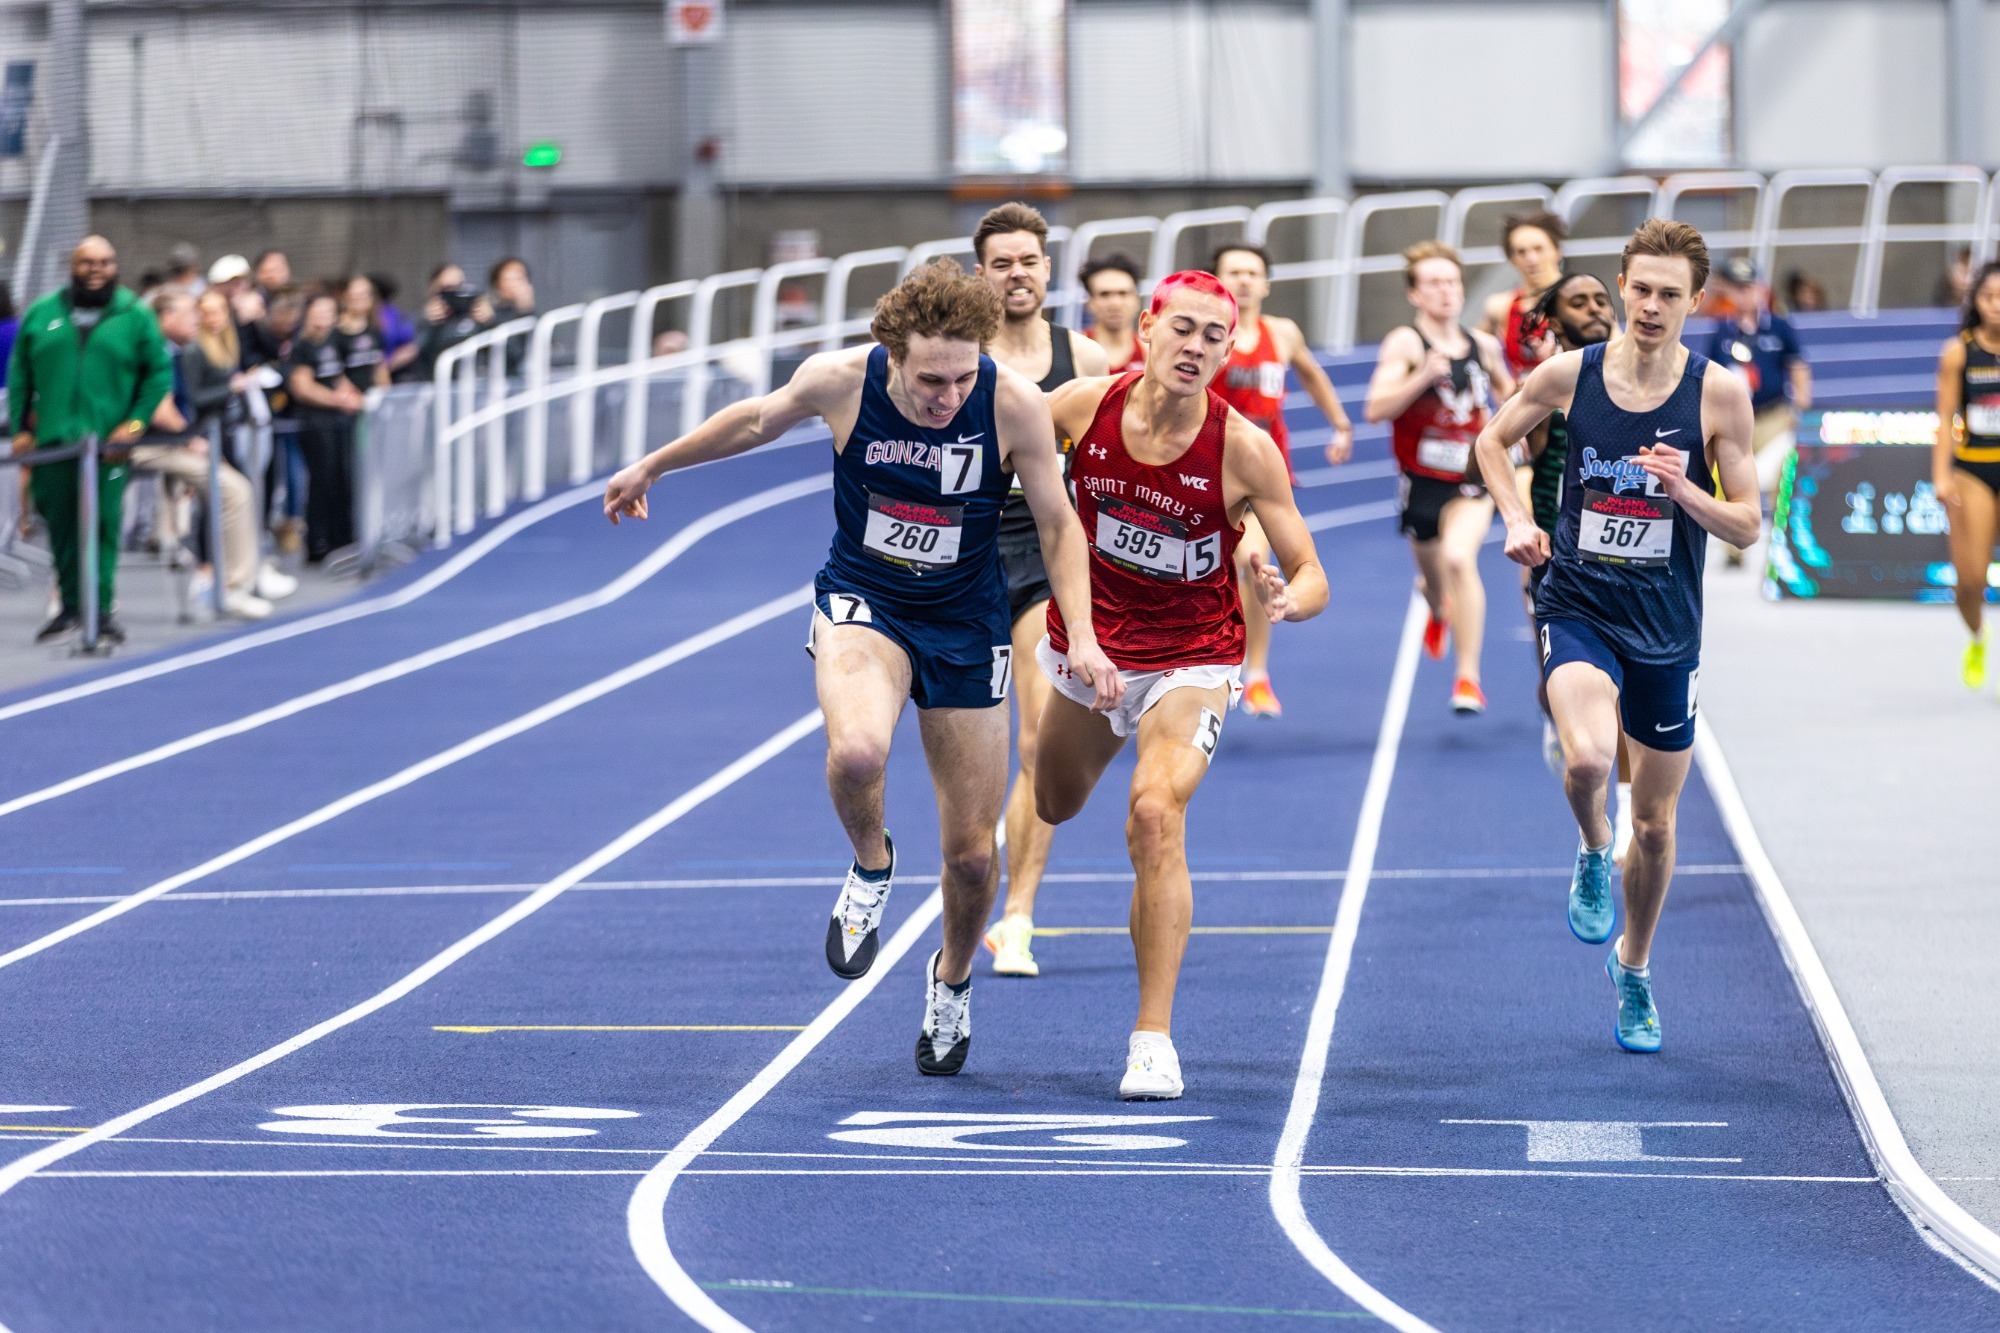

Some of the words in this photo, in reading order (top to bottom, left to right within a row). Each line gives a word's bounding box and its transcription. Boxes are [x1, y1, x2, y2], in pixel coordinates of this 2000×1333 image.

[951, 447, 974, 491] 7
[1179, 473, 1210, 491] WCC
[880, 505, 951, 524] INVITATIONAL
[1083, 476, 1127, 495] SAINT
[1135, 484, 1204, 525] MARY'S
[1123, 504, 1160, 523] INLAND
[1592, 502, 1663, 517] INVITATIONAL
[1607, 496, 1648, 507] INLAND
[1107, 507, 1173, 535] INVITATIONAL
[1600, 518, 1651, 547] 567
[884, 522, 940, 553] 260
[1114, 524, 1164, 559] 595
[1196, 537, 1214, 577] 5
[839, 596, 861, 620] 7
[1000, 649, 1009, 695] 7
[1201, 713, 1221, 755] 5
[257, 1103, 640, 1138] 3
[827, 1111, 1215, 1151] 2
